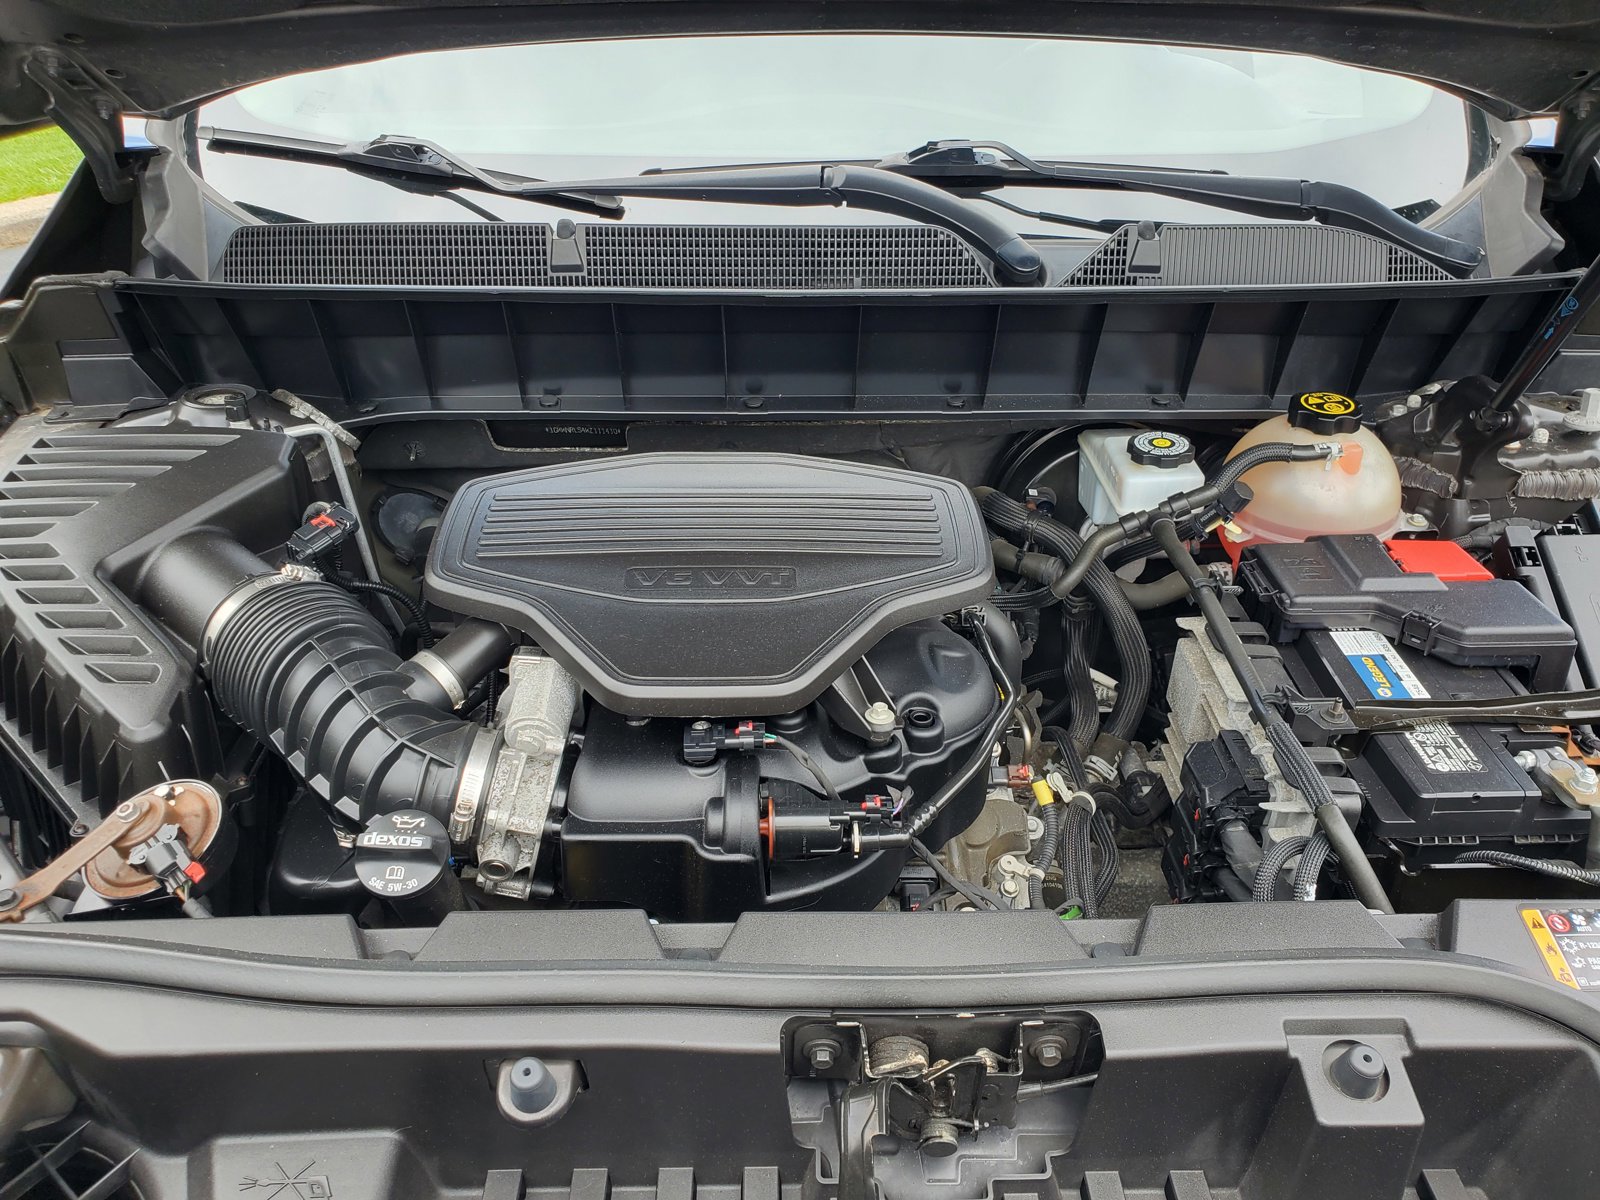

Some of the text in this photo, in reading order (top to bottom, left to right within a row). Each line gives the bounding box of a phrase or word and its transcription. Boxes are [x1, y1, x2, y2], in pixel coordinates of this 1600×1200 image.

[632, 569, 790, 586] V6 VVT
[1361, 656, 1393, 689] LEGEND
[363, 831, 424, 848] dexos
[368, 876, 419, 892] SAE 5W-30
